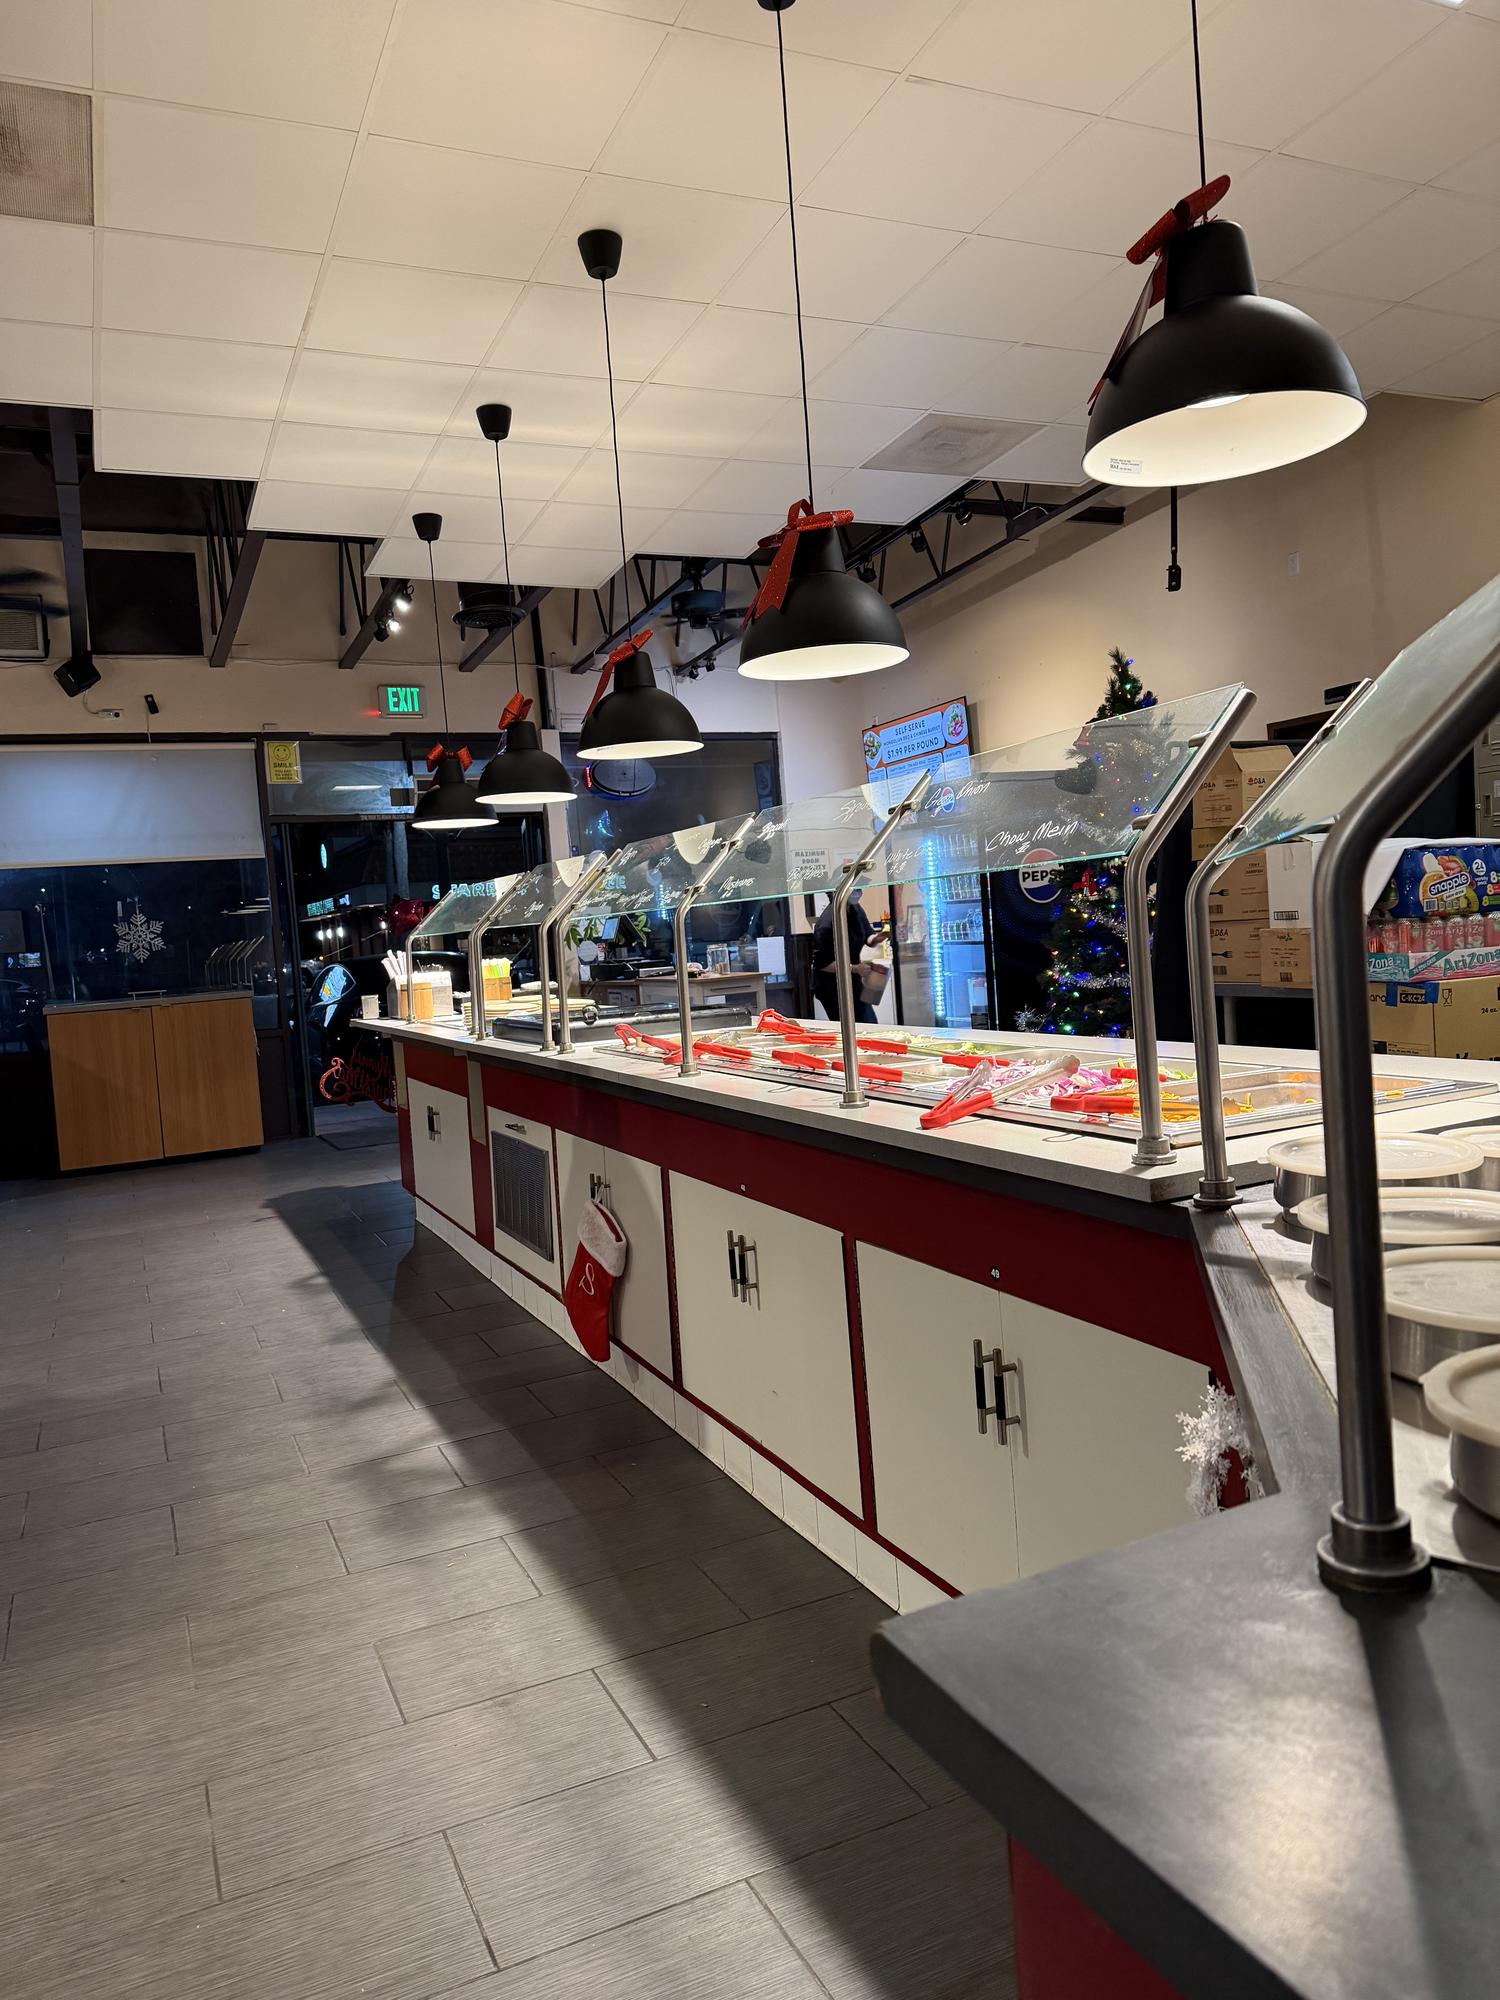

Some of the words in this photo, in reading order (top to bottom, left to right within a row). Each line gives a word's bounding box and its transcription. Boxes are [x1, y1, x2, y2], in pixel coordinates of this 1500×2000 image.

[387, 687, 420, 712] EXIT
[895, 725, 907, 736] SELF
[908, 720, 926, 733] SERVE
[887, 747, 902, 759] $7.99
[904, 743, 916, 754] PER
[916, 736, 939, 751] POUND
[986, 830, 1031, 851] Chow
[1031, 820, 1079, 841] Mein
[1022, 869, 1059, 883] PEPS
[1430, 873, 1468, 894] snapple
[1214, 928, 1229, 937] D&A
[1442, 948, 1500, 977] AriZona
